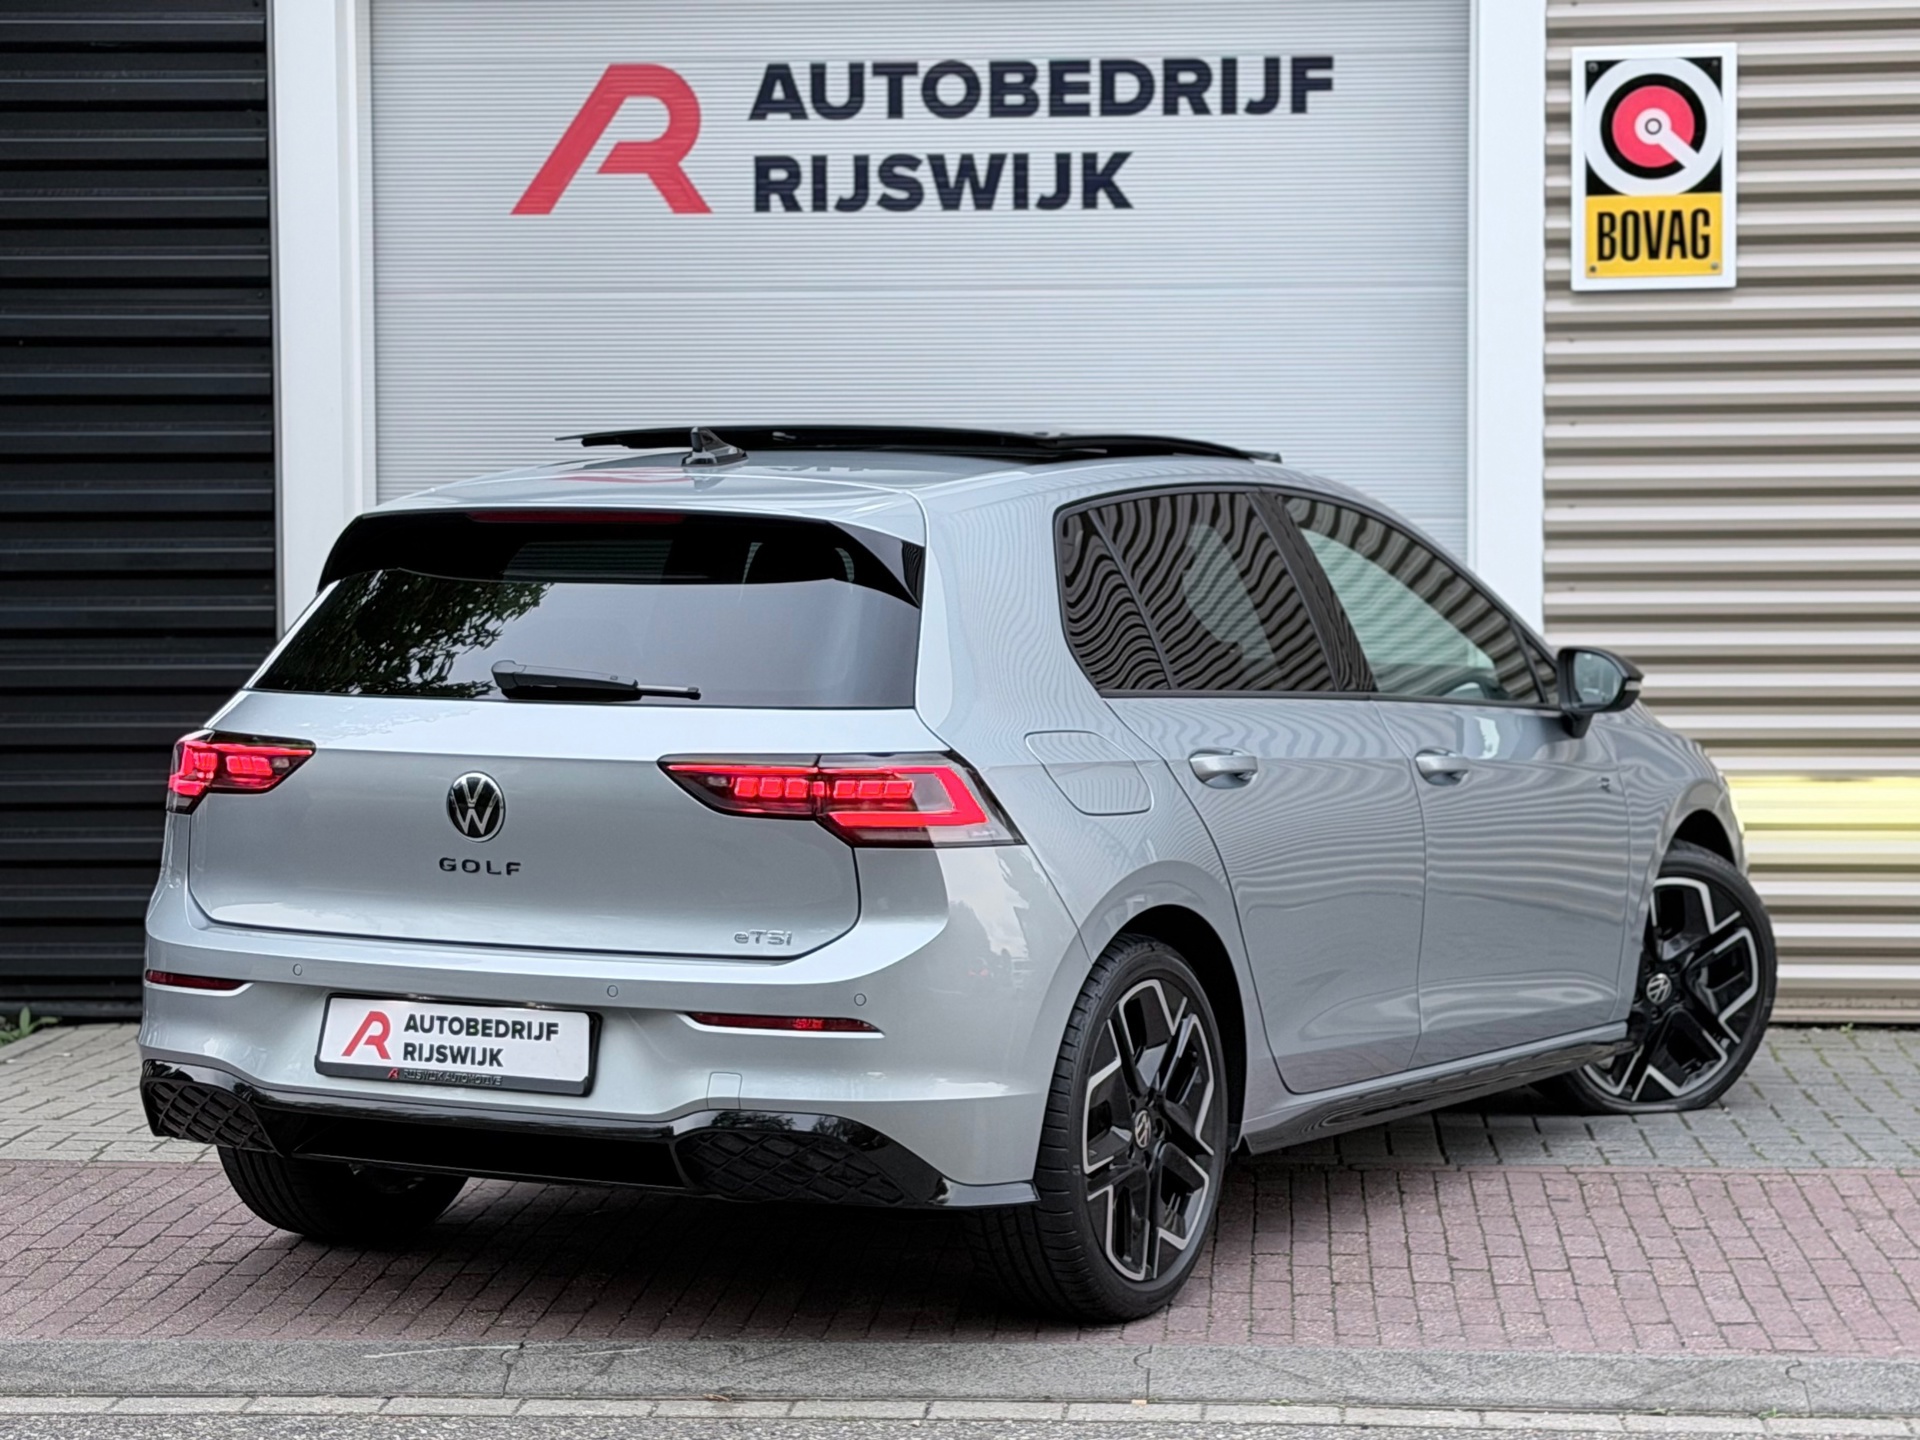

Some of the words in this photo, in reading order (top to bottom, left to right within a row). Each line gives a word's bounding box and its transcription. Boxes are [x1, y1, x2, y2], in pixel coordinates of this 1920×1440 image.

[748, 55, 1334, 121] AUTOBEDRIJF
[754, 151, 1133, 213] RIJSWIJK
[1597, 208, 1711, 262] BOVAG
[438, 856, 522, 876] GOLF
[403, 1013, 560, 1042] AUTOBEDRIJF
[402, 1042, 504, 1068] RIJSWIJK
